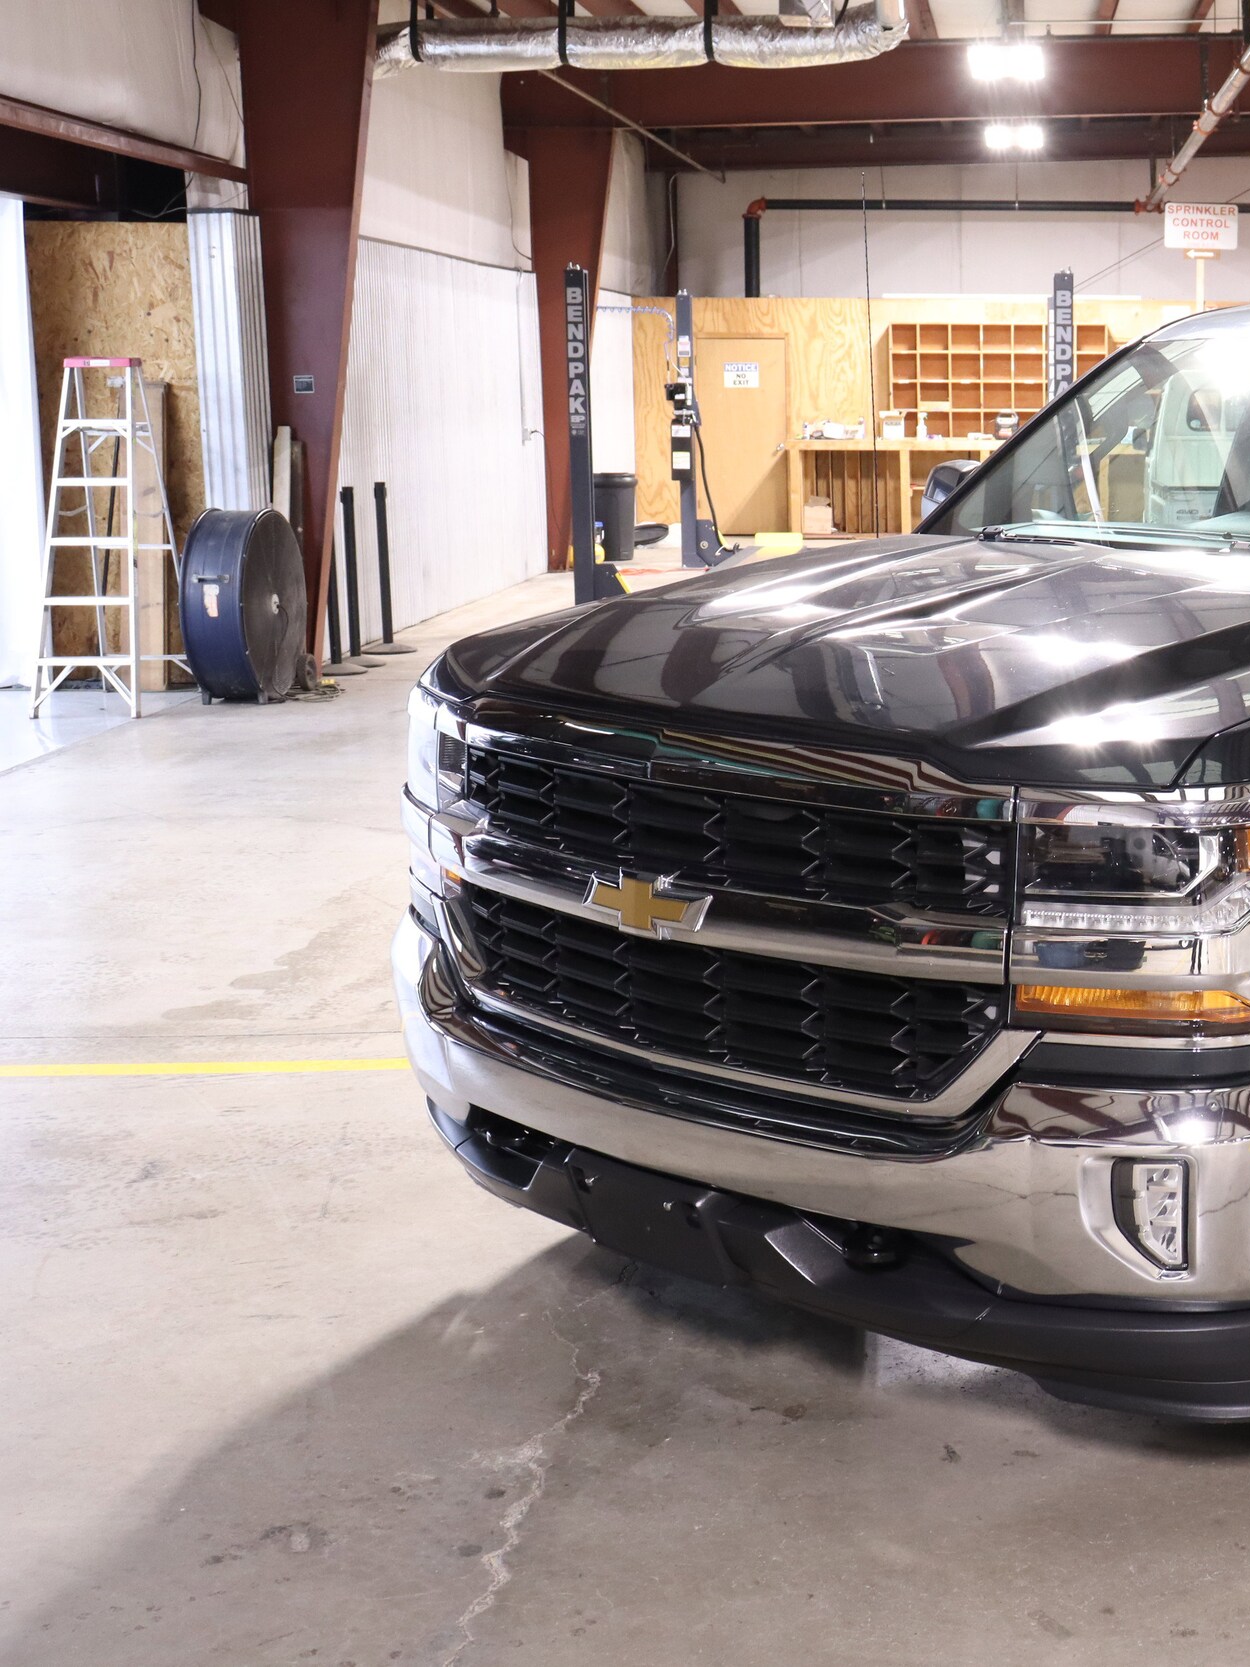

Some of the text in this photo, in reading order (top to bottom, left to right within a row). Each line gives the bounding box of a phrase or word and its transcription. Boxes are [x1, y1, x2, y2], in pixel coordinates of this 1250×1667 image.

[1167, 205, 1236, 216] SPRINKLER
[1172, 218, 1230, 228] CONTROL
[1183, 231, 1219, 240] ROOM
[1055, 290, 1072, 397] BENDPA
[566, 287, 586, 413] BENDPAK
[725, 363, 757, 371] NOTICE
